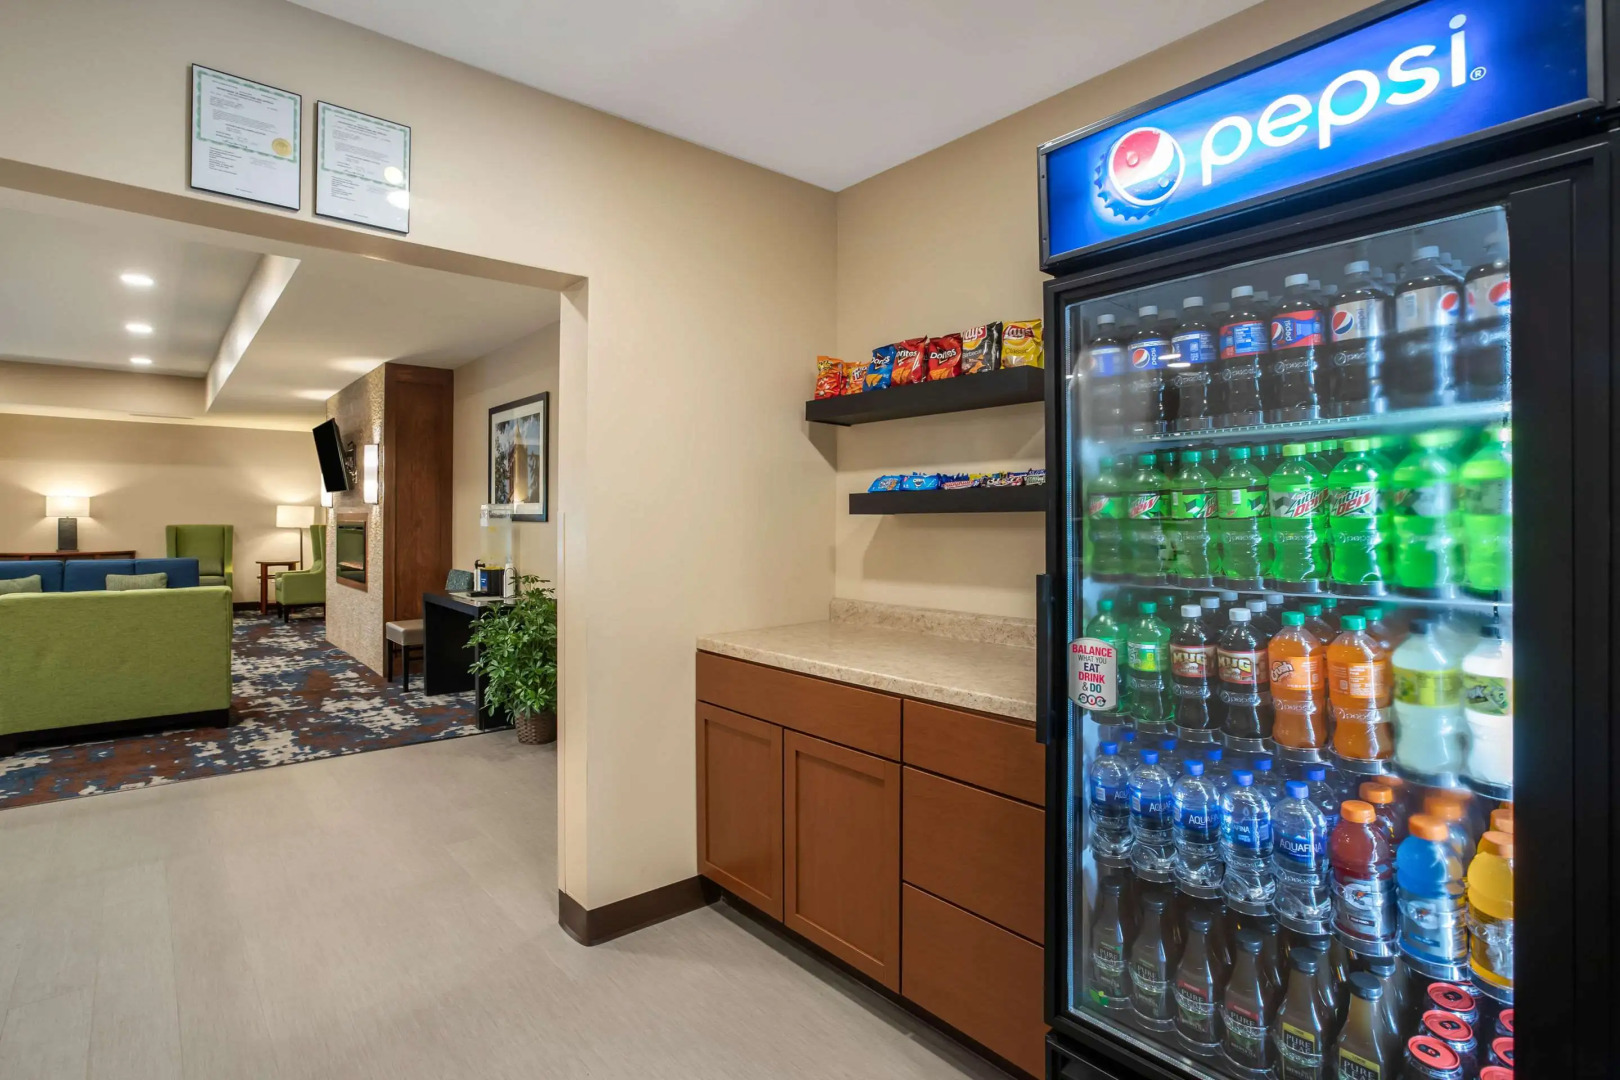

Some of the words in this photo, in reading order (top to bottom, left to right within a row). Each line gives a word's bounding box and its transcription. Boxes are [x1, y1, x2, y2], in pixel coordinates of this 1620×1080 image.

[1201, 14, 1467, 187] pepsi
[1072, 643, 1113, 658] BALANCE
[1078, 654, 1094, 662] WHAT
[1095, 656, 1107, 665] YOU
[1083, 662, 1100, 673] EAT
[1078, 671, 1106, 685] DRINK
[1082, 682, 1088, 691] &
[1089, 683, 1102, 693] DO
[1280, 839, 1324, 853] AQUAFINA
